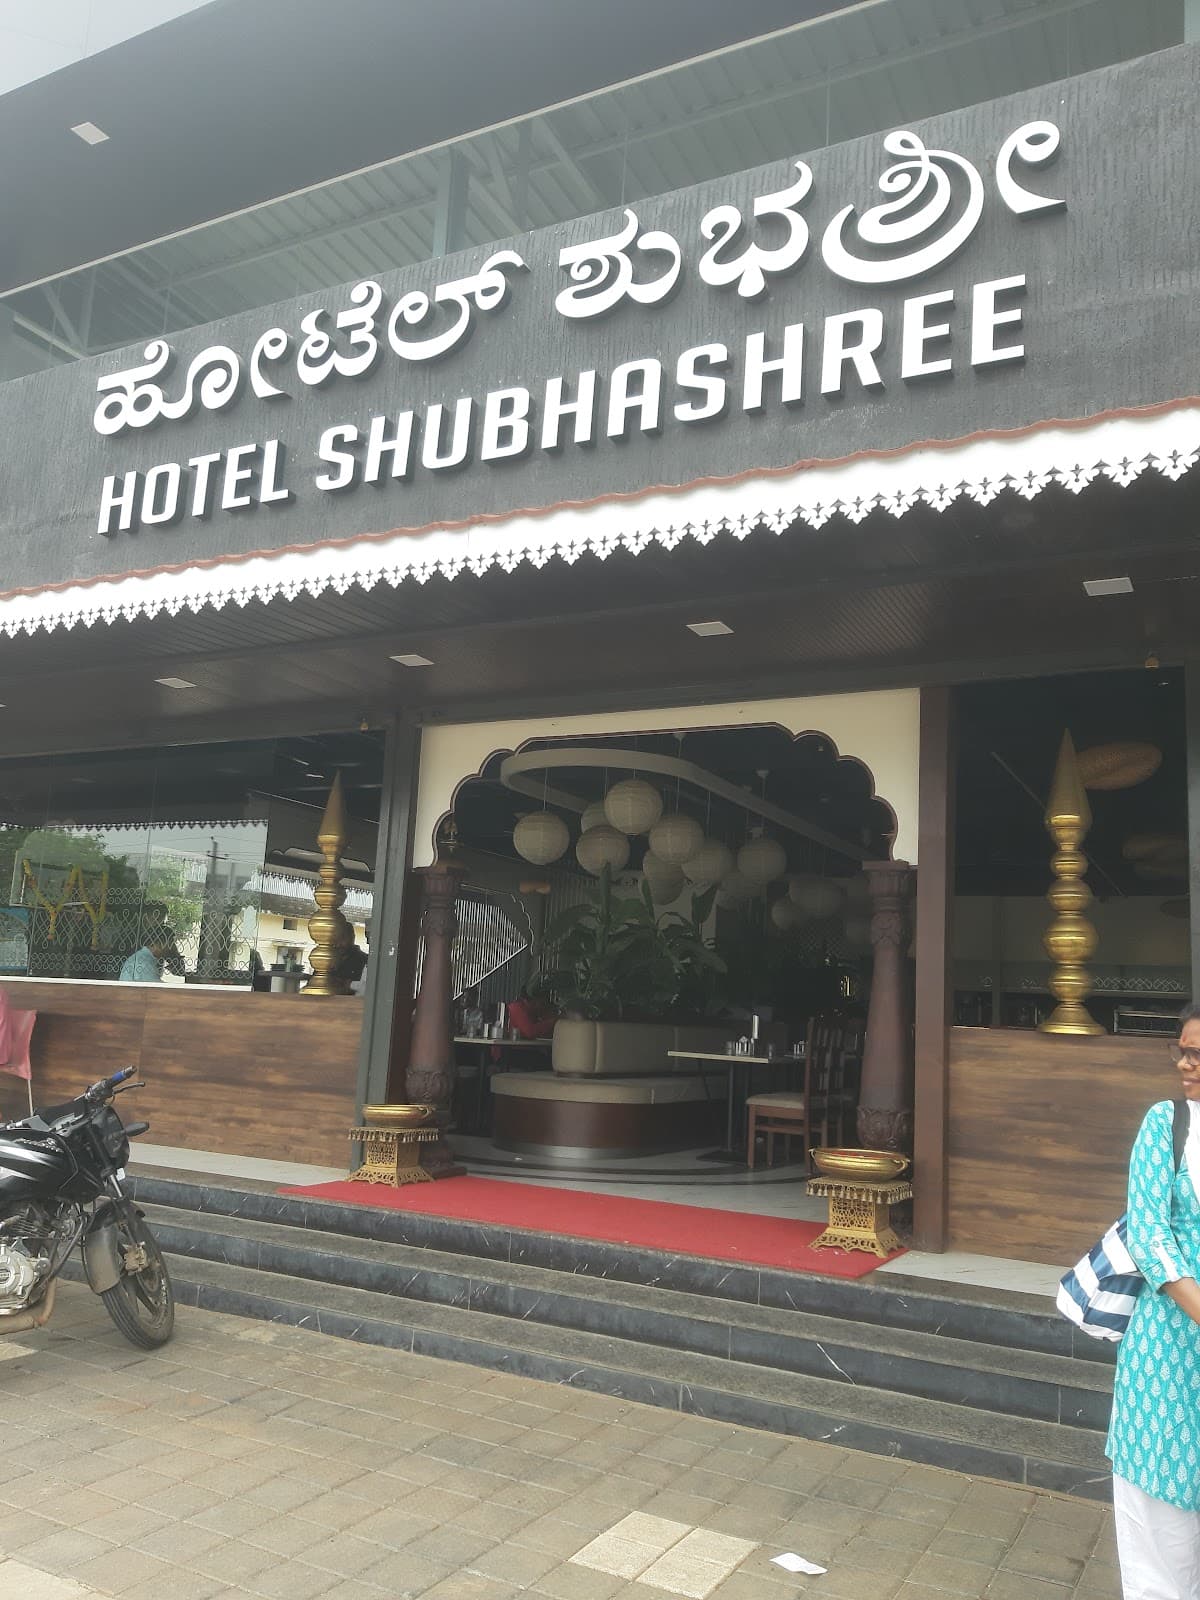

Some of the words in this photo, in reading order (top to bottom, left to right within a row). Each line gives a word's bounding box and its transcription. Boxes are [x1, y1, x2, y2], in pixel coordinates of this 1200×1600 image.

[93, 250, 526, 435] ಹೋಟೆಲ್
[555, 121, 1066, 318] ಶುಭಶ್ರೀ
[97, 439, 289, 534] HOTEL
[315, 273, 1026, 491] SHUBHASHREE
